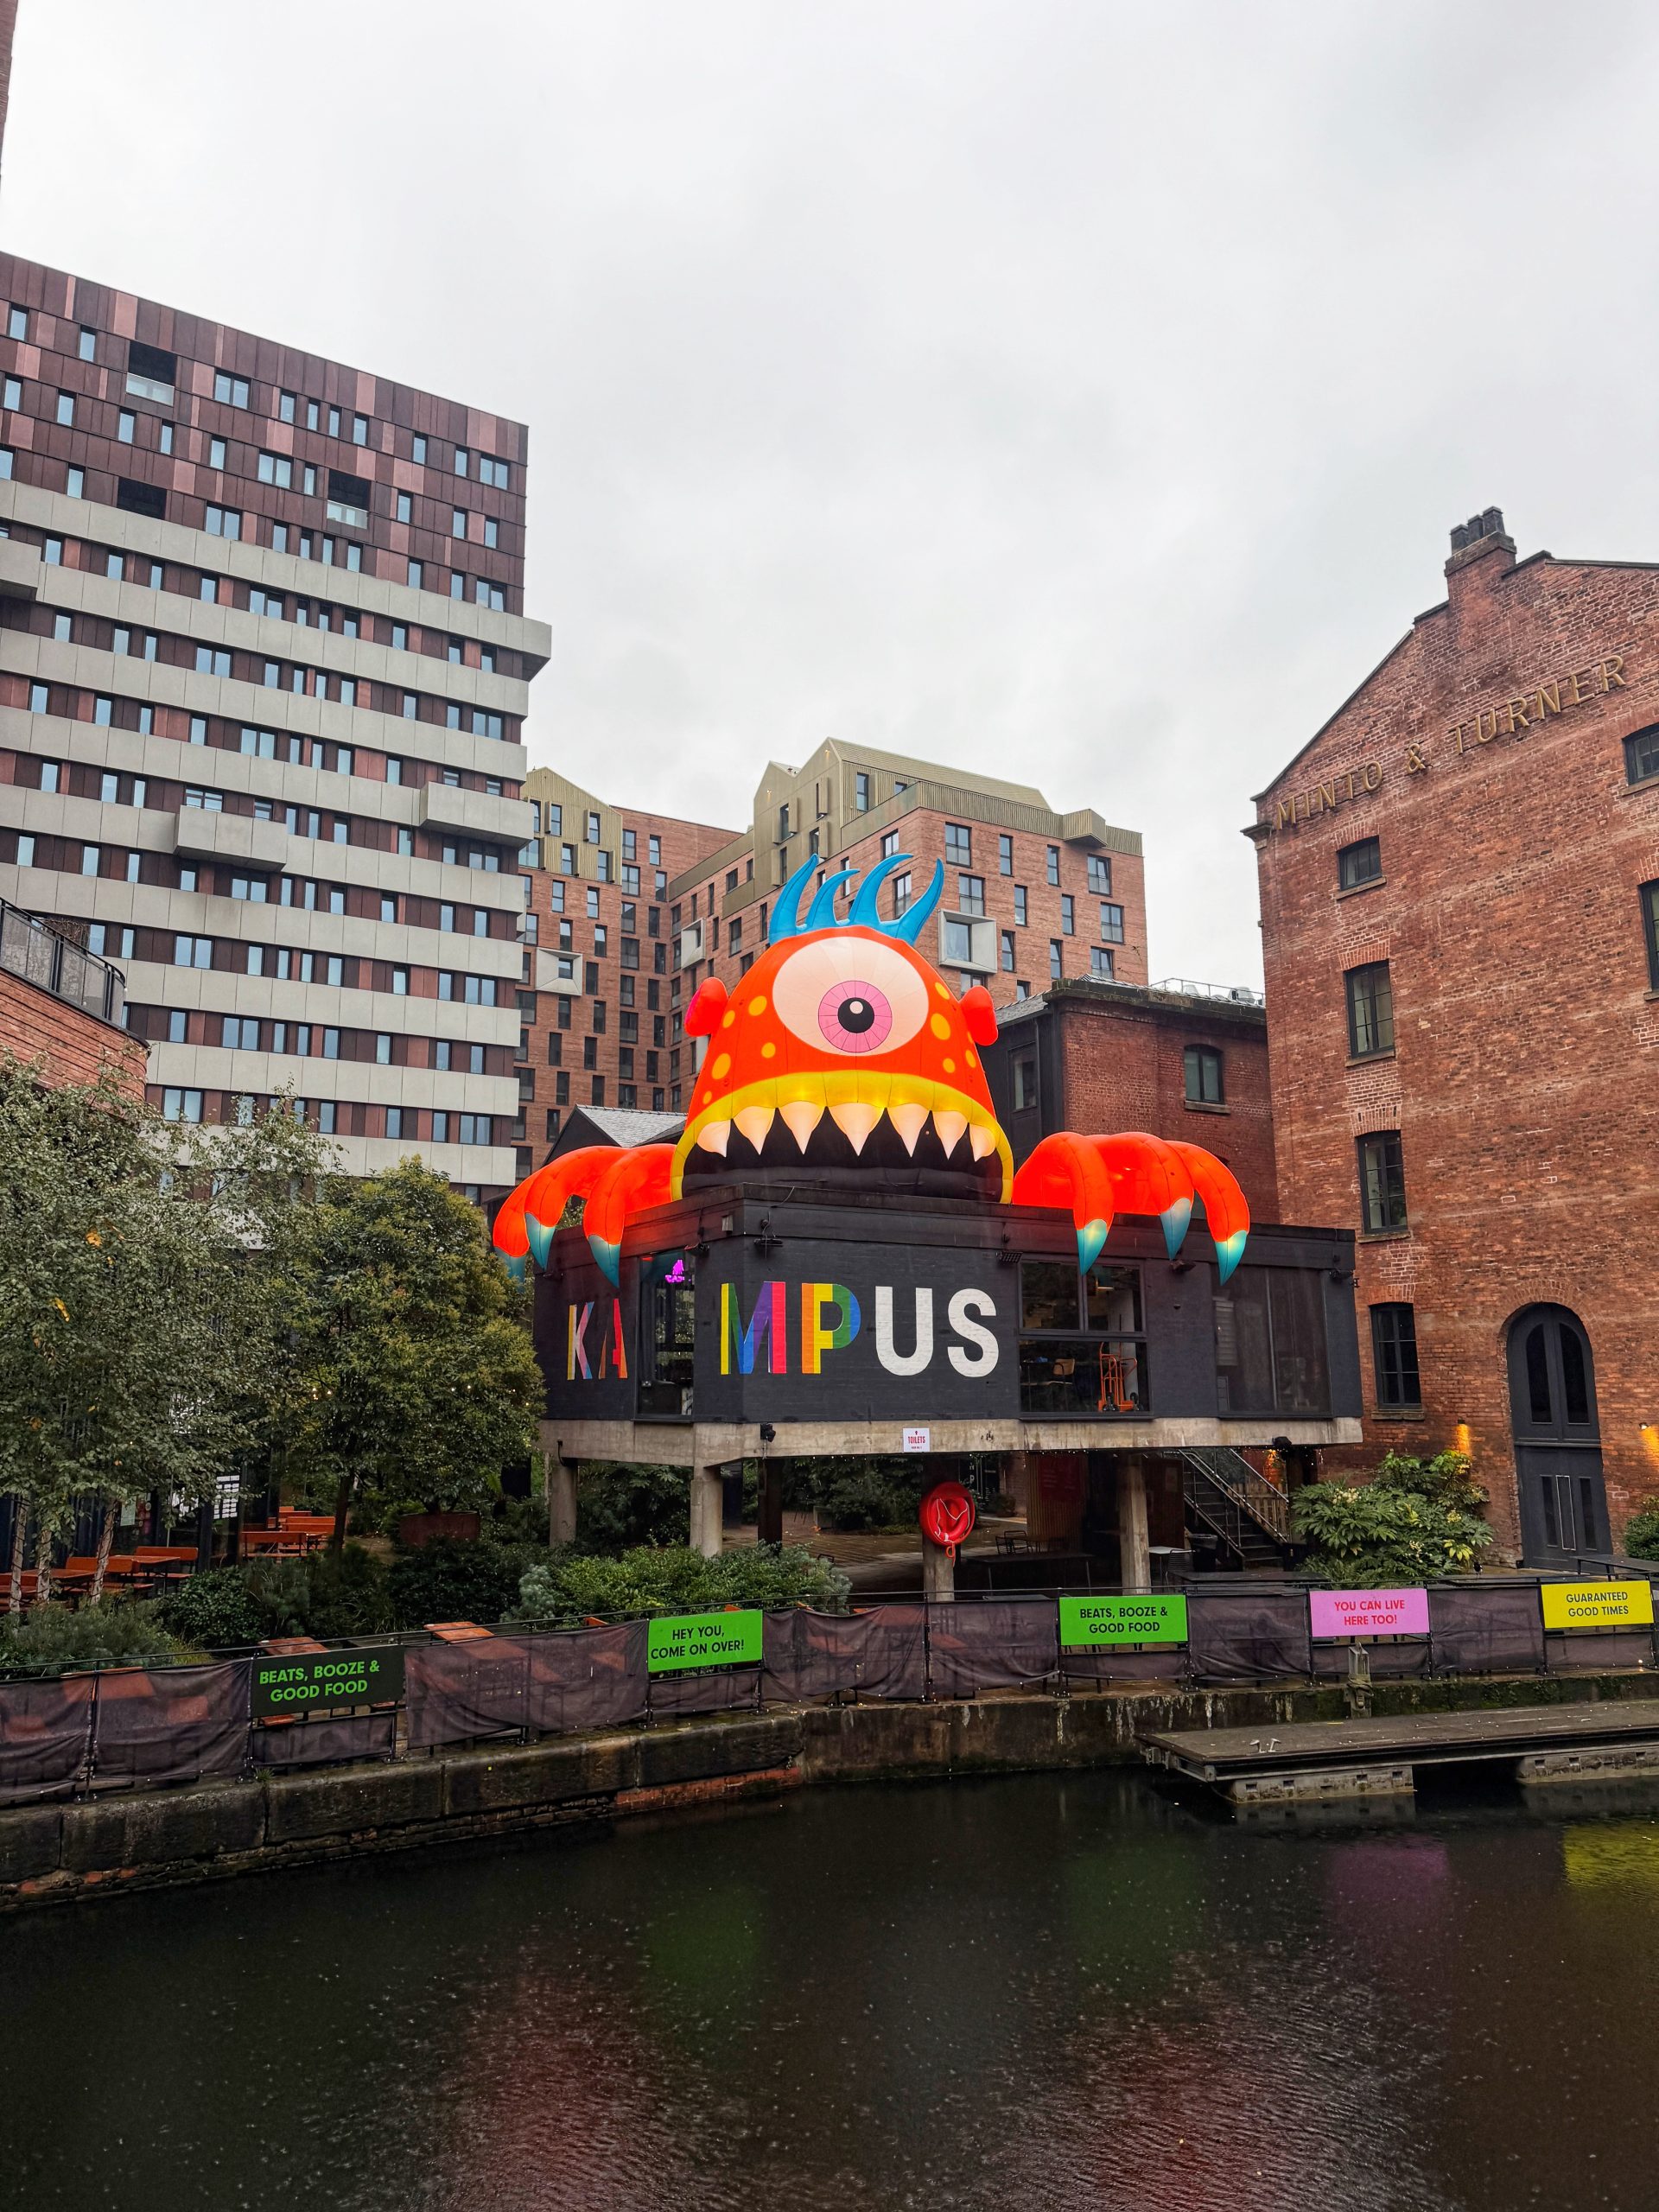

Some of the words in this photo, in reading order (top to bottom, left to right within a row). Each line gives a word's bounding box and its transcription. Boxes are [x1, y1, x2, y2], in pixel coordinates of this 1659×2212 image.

[1275, 760, 1382, 830] MINTO
[1405, 741, 1427, 774] &
[1449, 654, 1626, 755] TURNER
[1566, 1592, 1628, 1603] GUARANTEED
[1334, 1601, 1356, 1611] YOU
[1359, 1600, 1382, 1611] CAN
[1385, 1599, 1405, 1610] LIVE
[1568, 1606, 1599, 1617] GOOD
[1601, 1605, 1629, 1616] TIMES
[1080, 1608, 1116, 1618] BEATS,
[1119, 1606, 1156, 1618] BOOZE
[1160, 1606, 1168, 1616] &
[1344, 1615, 1369, 1625] HERE
[1371, 1614, 1397, 1624] TOO!
[672, 1627, 694, 1641] HEY
[698, 1625, 725, 1638] YOU,
[1089, 1623, 1125, 1634] GOOD
[1128, 1622, 1160, 1632] FOOD
[651, 1645, 685, 1659] COME
[690, 1643, 708, 1656] ON
[711, 1639, 744, 1653] OVER!
[259, 1667, 308, 1684] BEATS,
[314, 1661, 365, 1679] BOOZE
[369, 1660, 380, 1672] &
[270, 1685, 320, 1702] GOOD
[324, 1680, 368, 1696] FOOD
